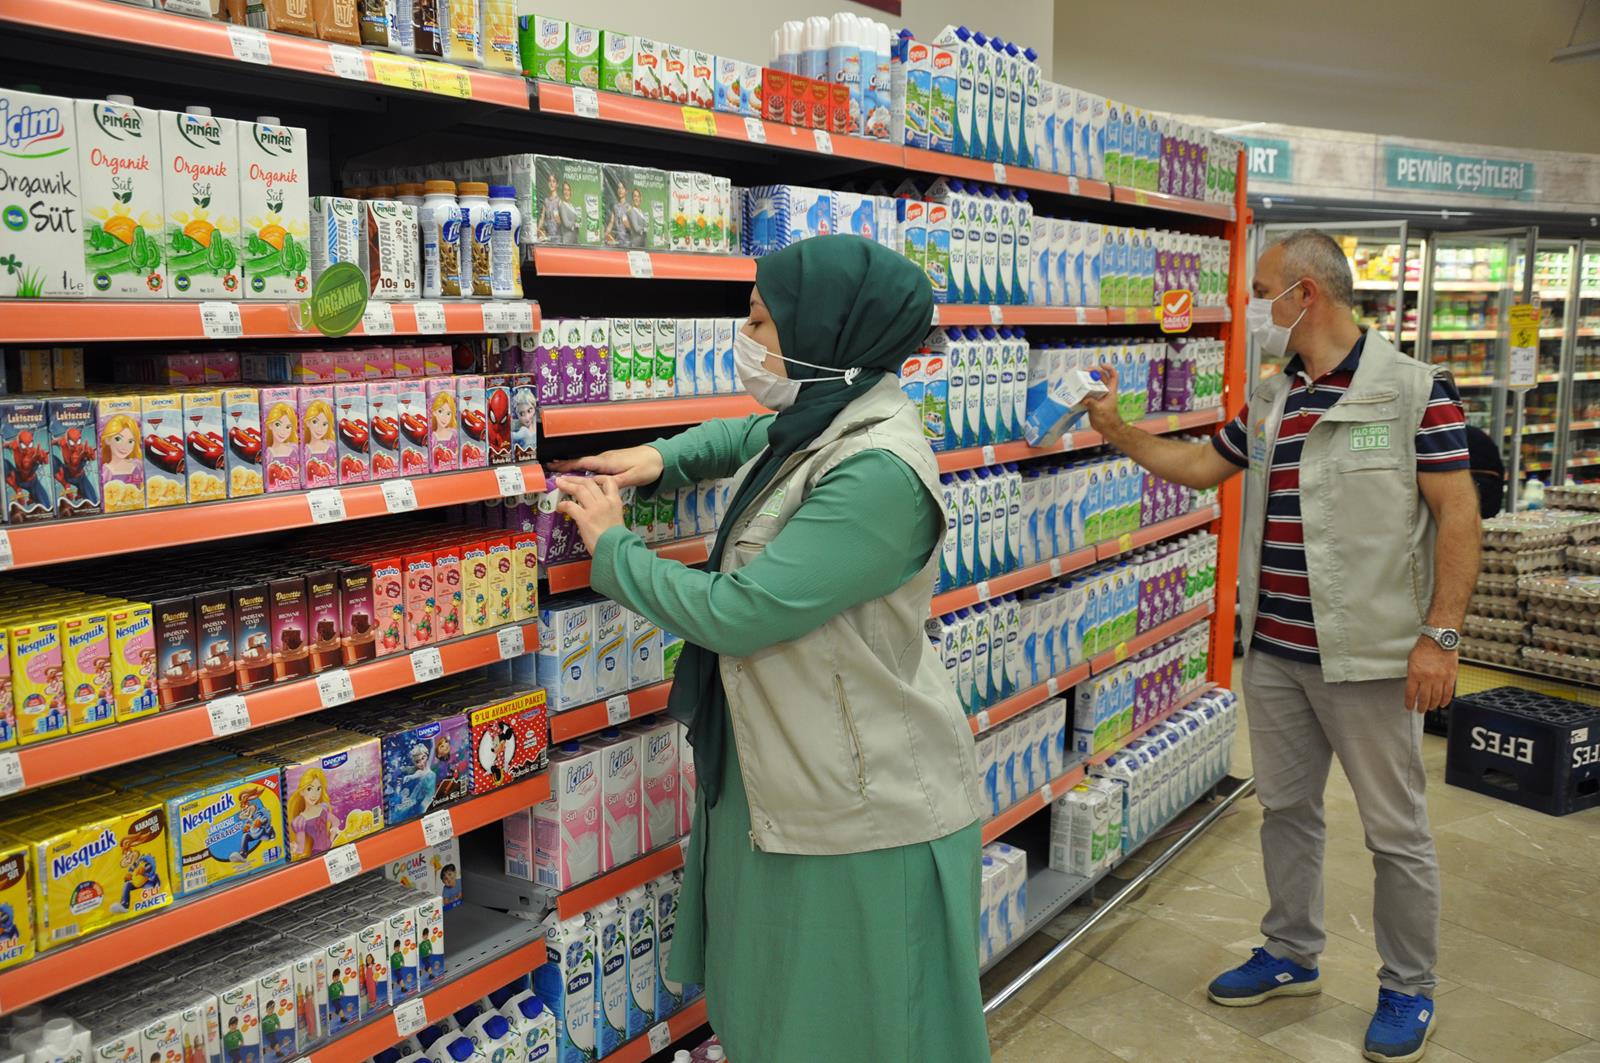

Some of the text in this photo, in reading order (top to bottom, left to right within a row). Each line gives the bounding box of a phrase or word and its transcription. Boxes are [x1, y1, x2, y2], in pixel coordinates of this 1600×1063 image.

[91, 148, 150, 175] Organik
[174, 156, 227, 181] Organik
[112, 177, 133, 191] Süt
[250, 164, 298, 187] Organik
[1398, 156, 1524, 191] PEYNİR ÇEŞİTLERİ
[30, 201, 76, 233] Süt
[380, 220, 393, 273] PROTEIN
[69, 624, 105, 647] Nesquik
[115, 616, 150, 639] Nesquik
[17, 632, 56, 656] Nesquik
[418, 724, 440, 736] DANONE
[1471, 726, 1535, 764] EFES
[1572, 743, 1600, 769] FES
[323, 753, 347, 766] DANONE
[182, 793, 235, 833] Nesquik
[53, 830, 117, 879] Nesquik
[393, 853, 426, 879] Çocuk
[134, 894, 167, 911] PAKET
[661, 926, 673, 940] Tork
[633, 942, 651, 957] Torku
[605, 958, 622, 973] Torku
[569, 977, 588, 992] Torku
[531, 1045, 547, 1059] Torku
